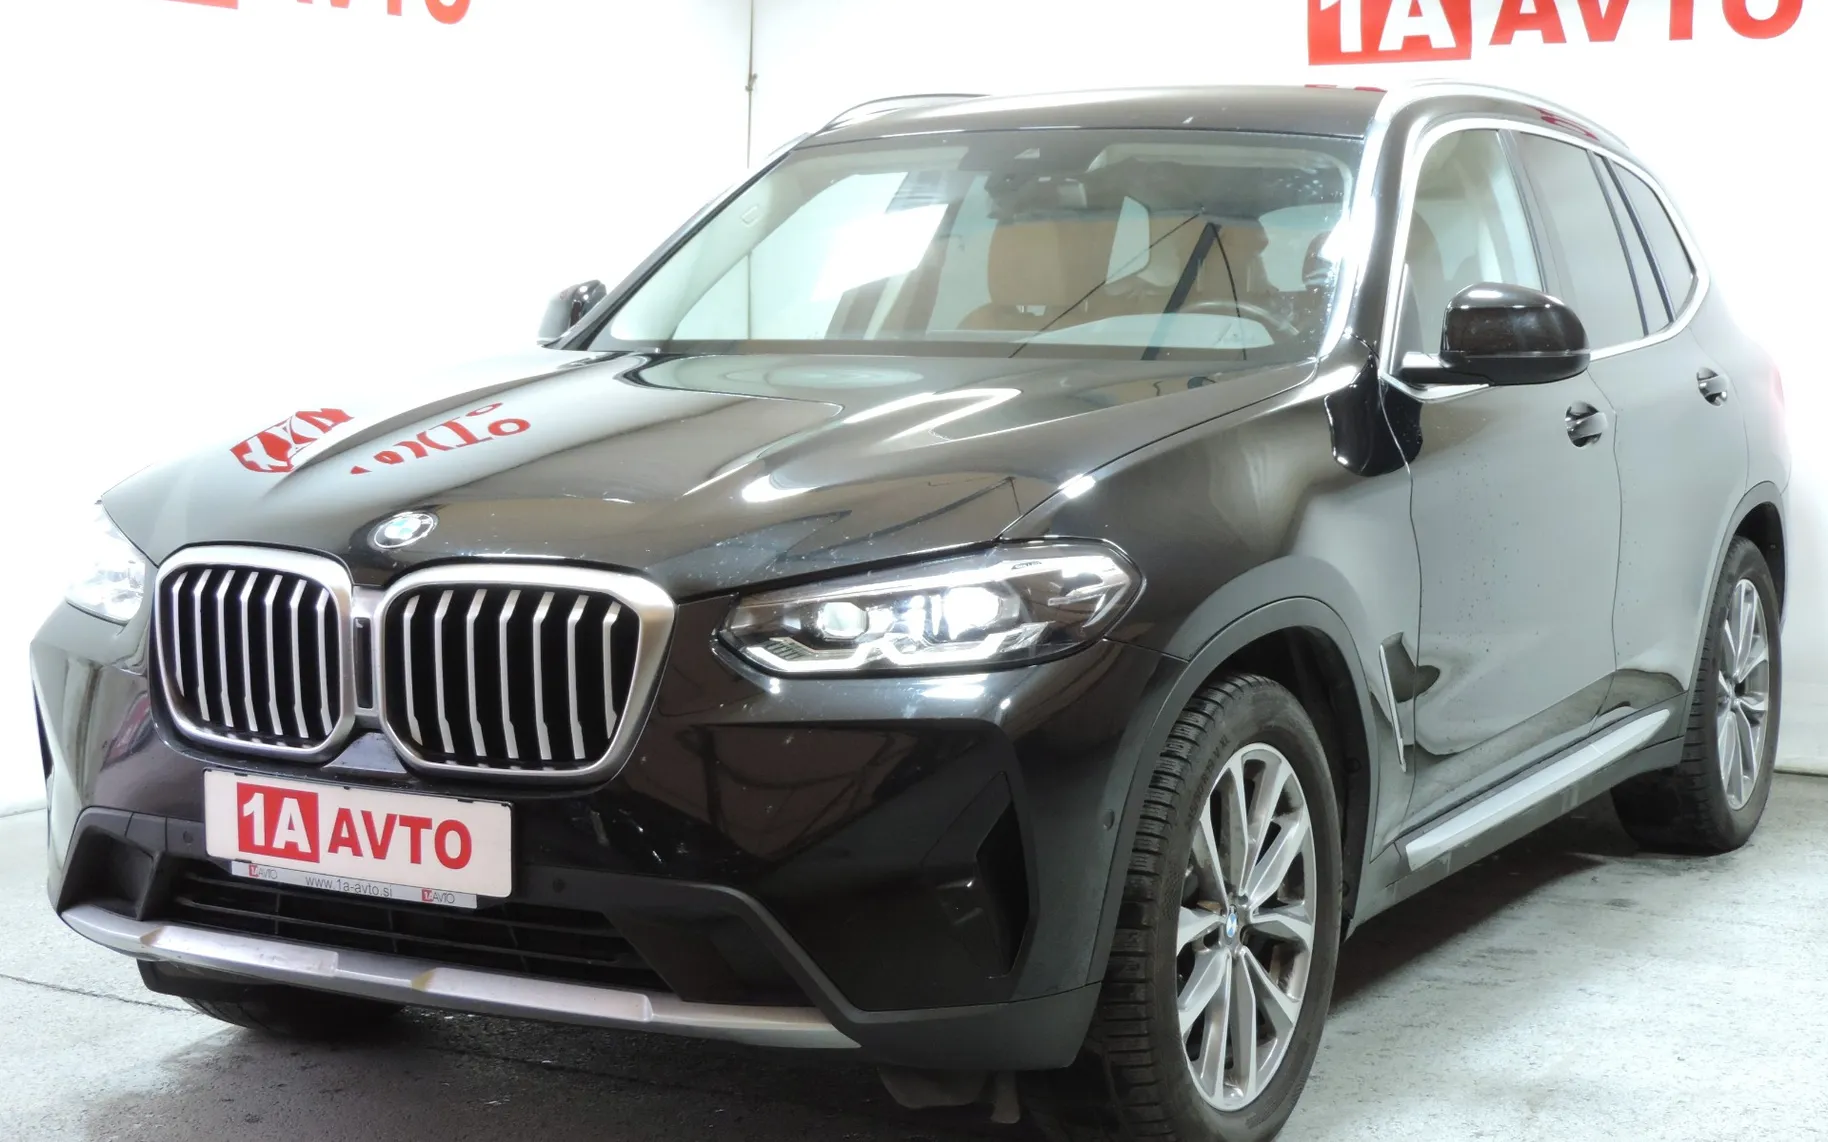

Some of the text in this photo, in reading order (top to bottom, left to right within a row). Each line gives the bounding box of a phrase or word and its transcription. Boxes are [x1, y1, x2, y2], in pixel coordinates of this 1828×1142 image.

[1319, 0, 1457, 53] 1A
[242, 791, 473, 870] 1A AVTO
[305, 876, 393, 898] www.1a-avto.si
